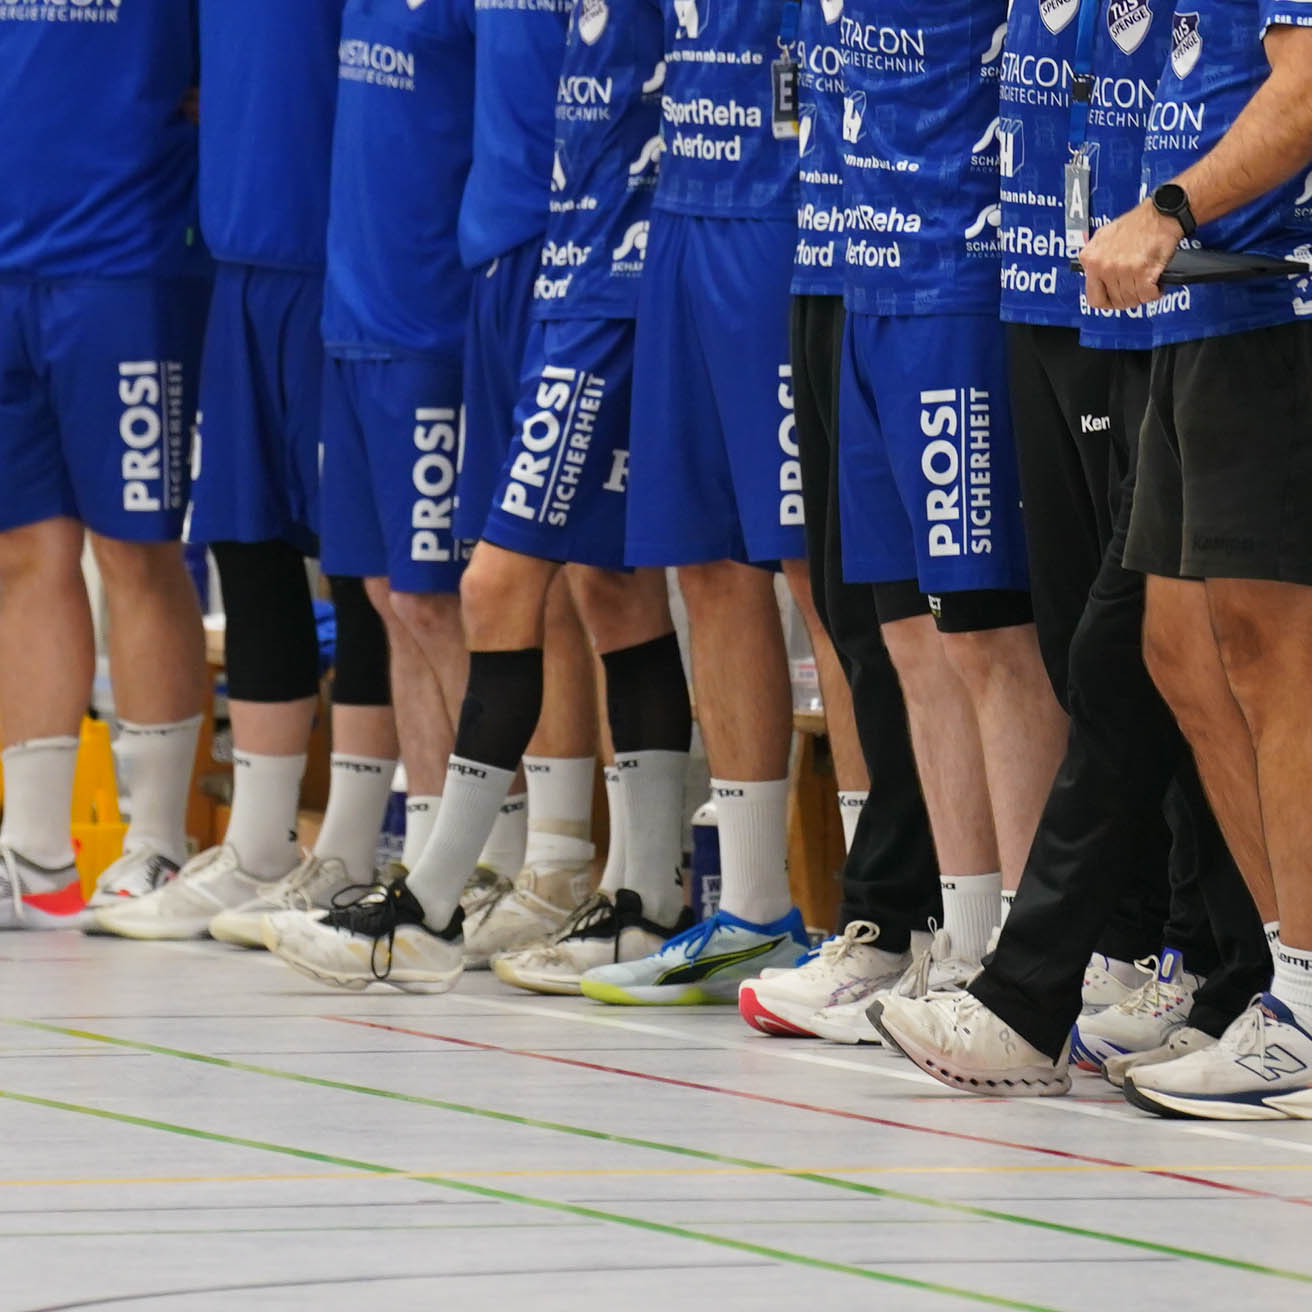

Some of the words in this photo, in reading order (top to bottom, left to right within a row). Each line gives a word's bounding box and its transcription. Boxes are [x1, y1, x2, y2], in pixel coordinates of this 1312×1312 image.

[779, 73, 793, 112] E
[1111, 7, 1148, 38] SPENGE
[661, 94, 762, 128] SportReha
[1070, 177, 1085, 220] A
[119, 360, 161, 511] PROSI
[411, 407, 455, 562] PROSI
[500, 365, 577, 520] PROSI
[548, 372, 606, 527] SICHERHEIT
[920, 388, 960, 557] PROSI
[969, 387, 992, 554] SICHERHEIT
